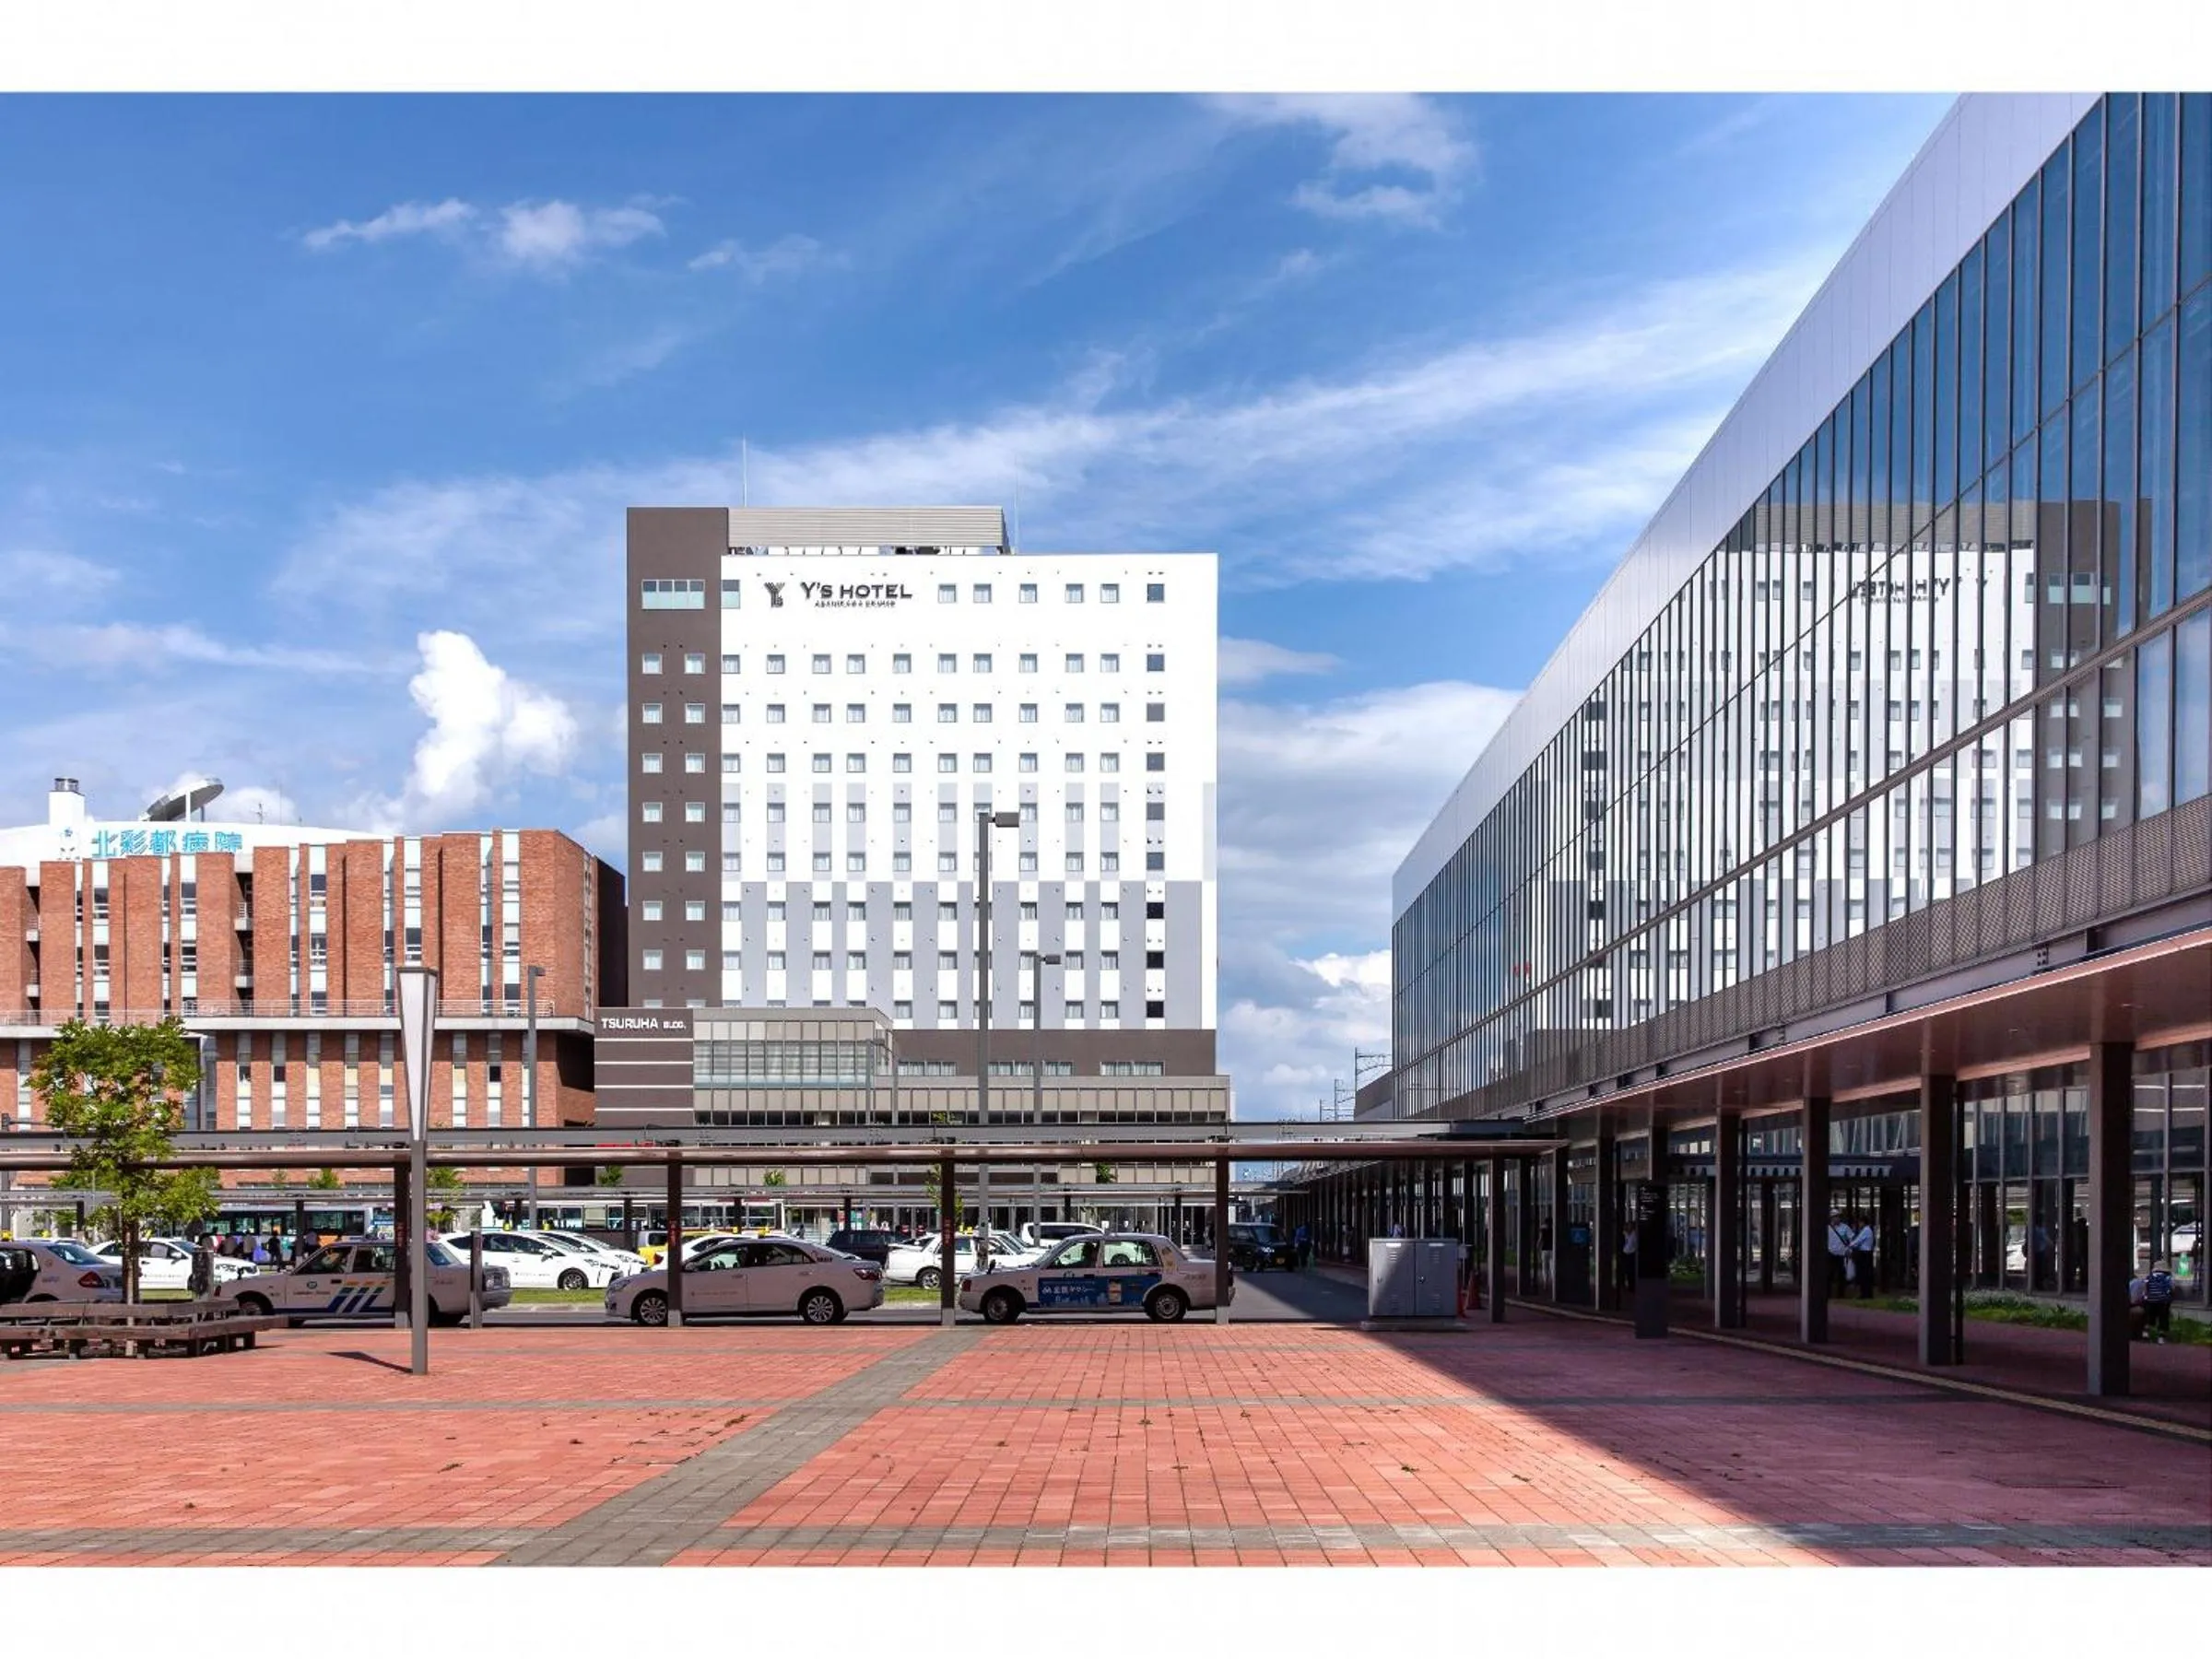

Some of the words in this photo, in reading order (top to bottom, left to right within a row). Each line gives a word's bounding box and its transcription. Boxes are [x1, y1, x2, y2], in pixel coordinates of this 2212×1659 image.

[840, 584, 912, 599] HOTEL
[91, 830, 243, 858] 北彩都病院
[601, 1018, 658, 1029] TSURUHA
